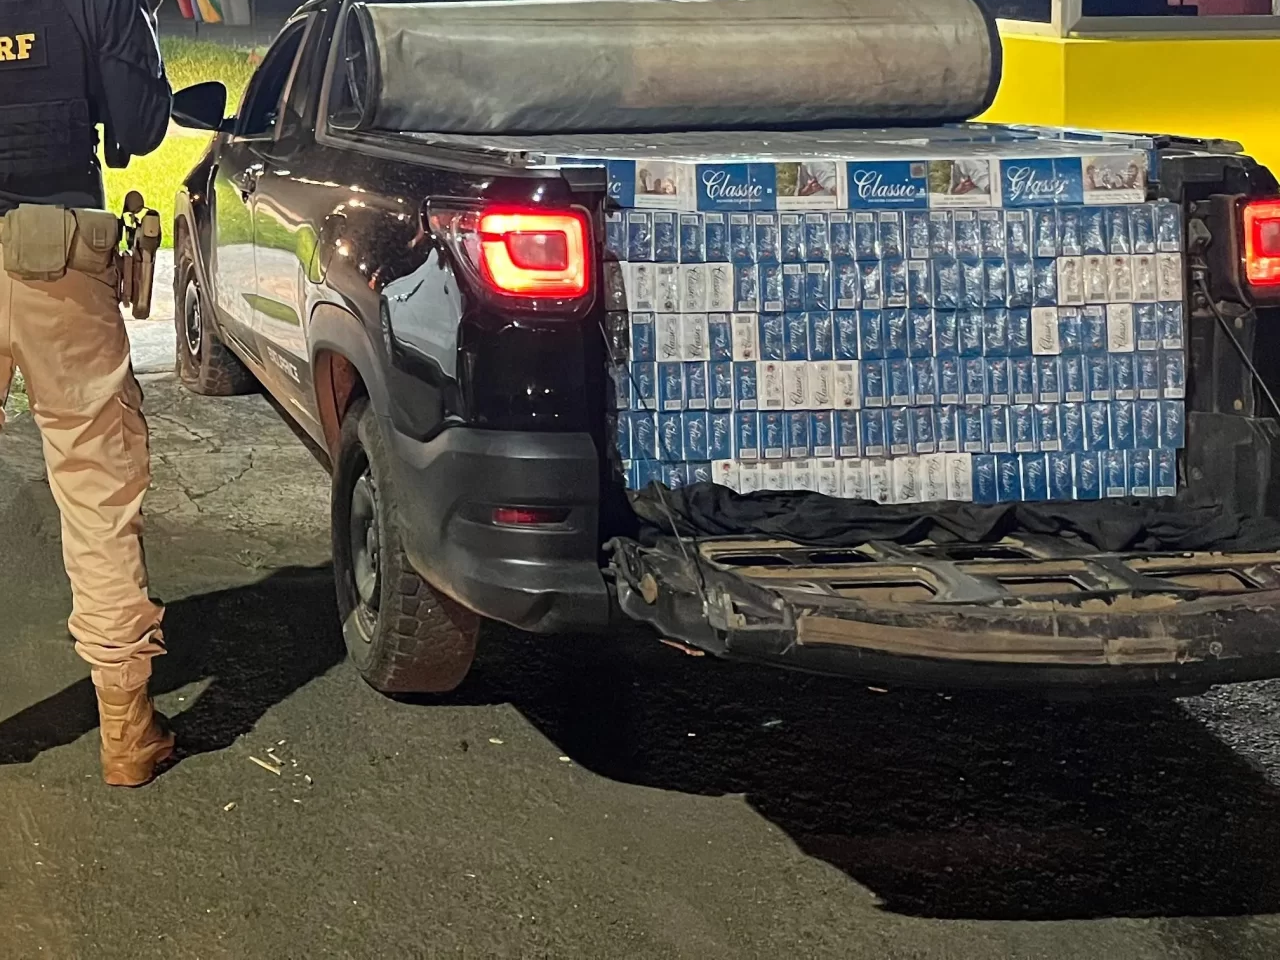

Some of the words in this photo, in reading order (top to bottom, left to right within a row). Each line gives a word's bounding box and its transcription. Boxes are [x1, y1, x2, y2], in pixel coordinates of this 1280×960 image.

[702, 170, 762, 200] Classic
[854, 170, 915, 200] Classic
[1007, 166, 1069, 200] Classic
